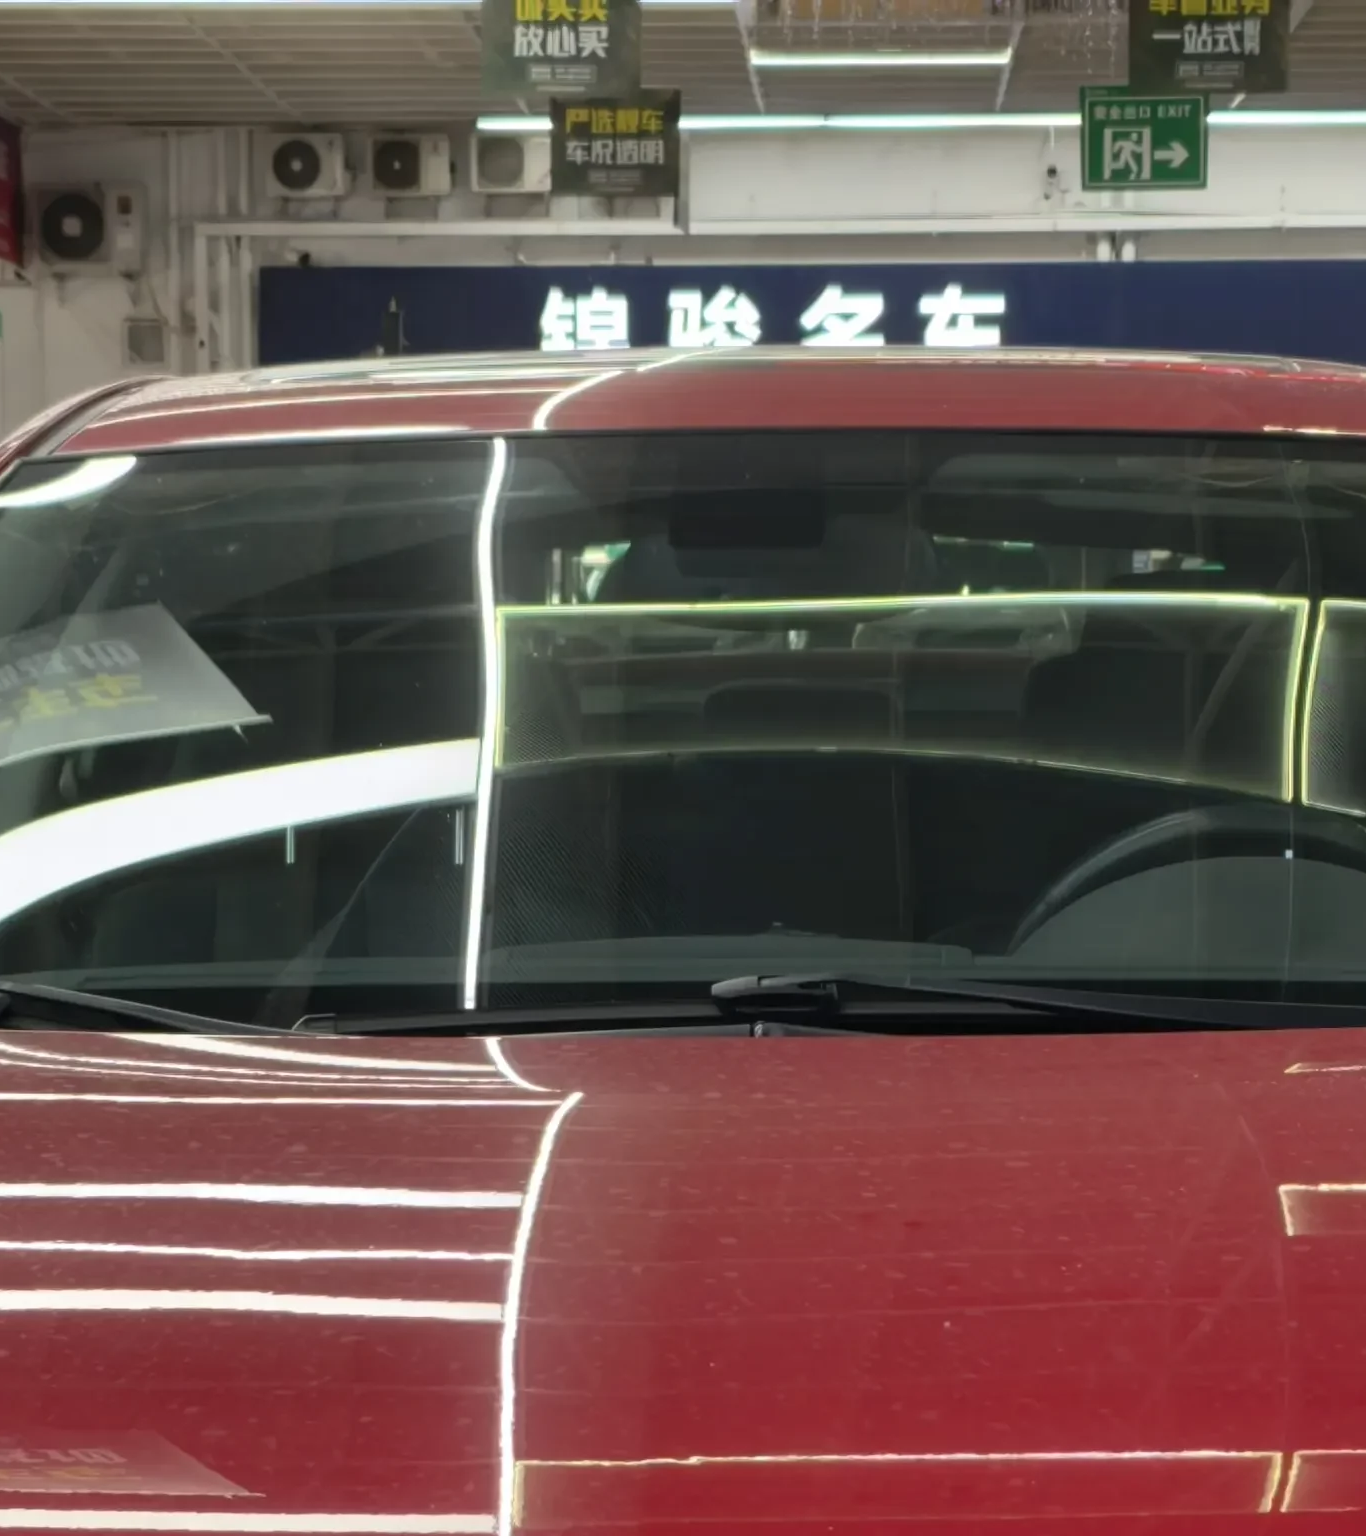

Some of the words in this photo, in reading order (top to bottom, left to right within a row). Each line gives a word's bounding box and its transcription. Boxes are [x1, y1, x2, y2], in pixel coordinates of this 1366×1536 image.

[513, 25, 609, 58] 放心买
[1157, 104, 1192, 119] EXIT
